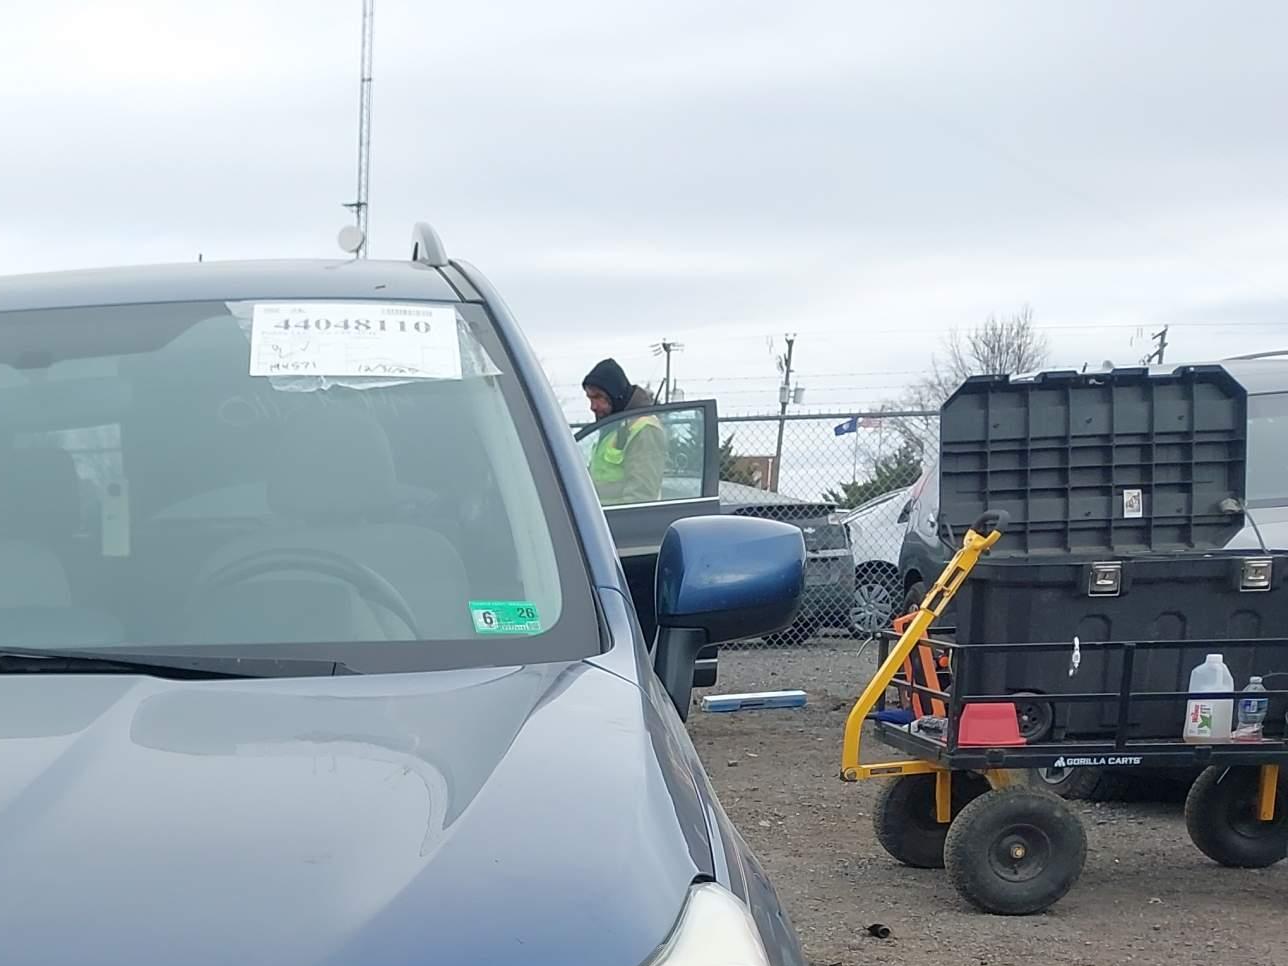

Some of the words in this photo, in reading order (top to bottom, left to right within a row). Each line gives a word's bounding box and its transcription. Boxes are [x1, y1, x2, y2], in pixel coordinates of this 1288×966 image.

[273, 317, 432, 334] 44048110
[482, 610, 494, 626] 6
[517, 607, 535, 619] 26
[1066, 757, 1106, 766] GORILLA
[1108, 756, 1142, 765] CARTS
